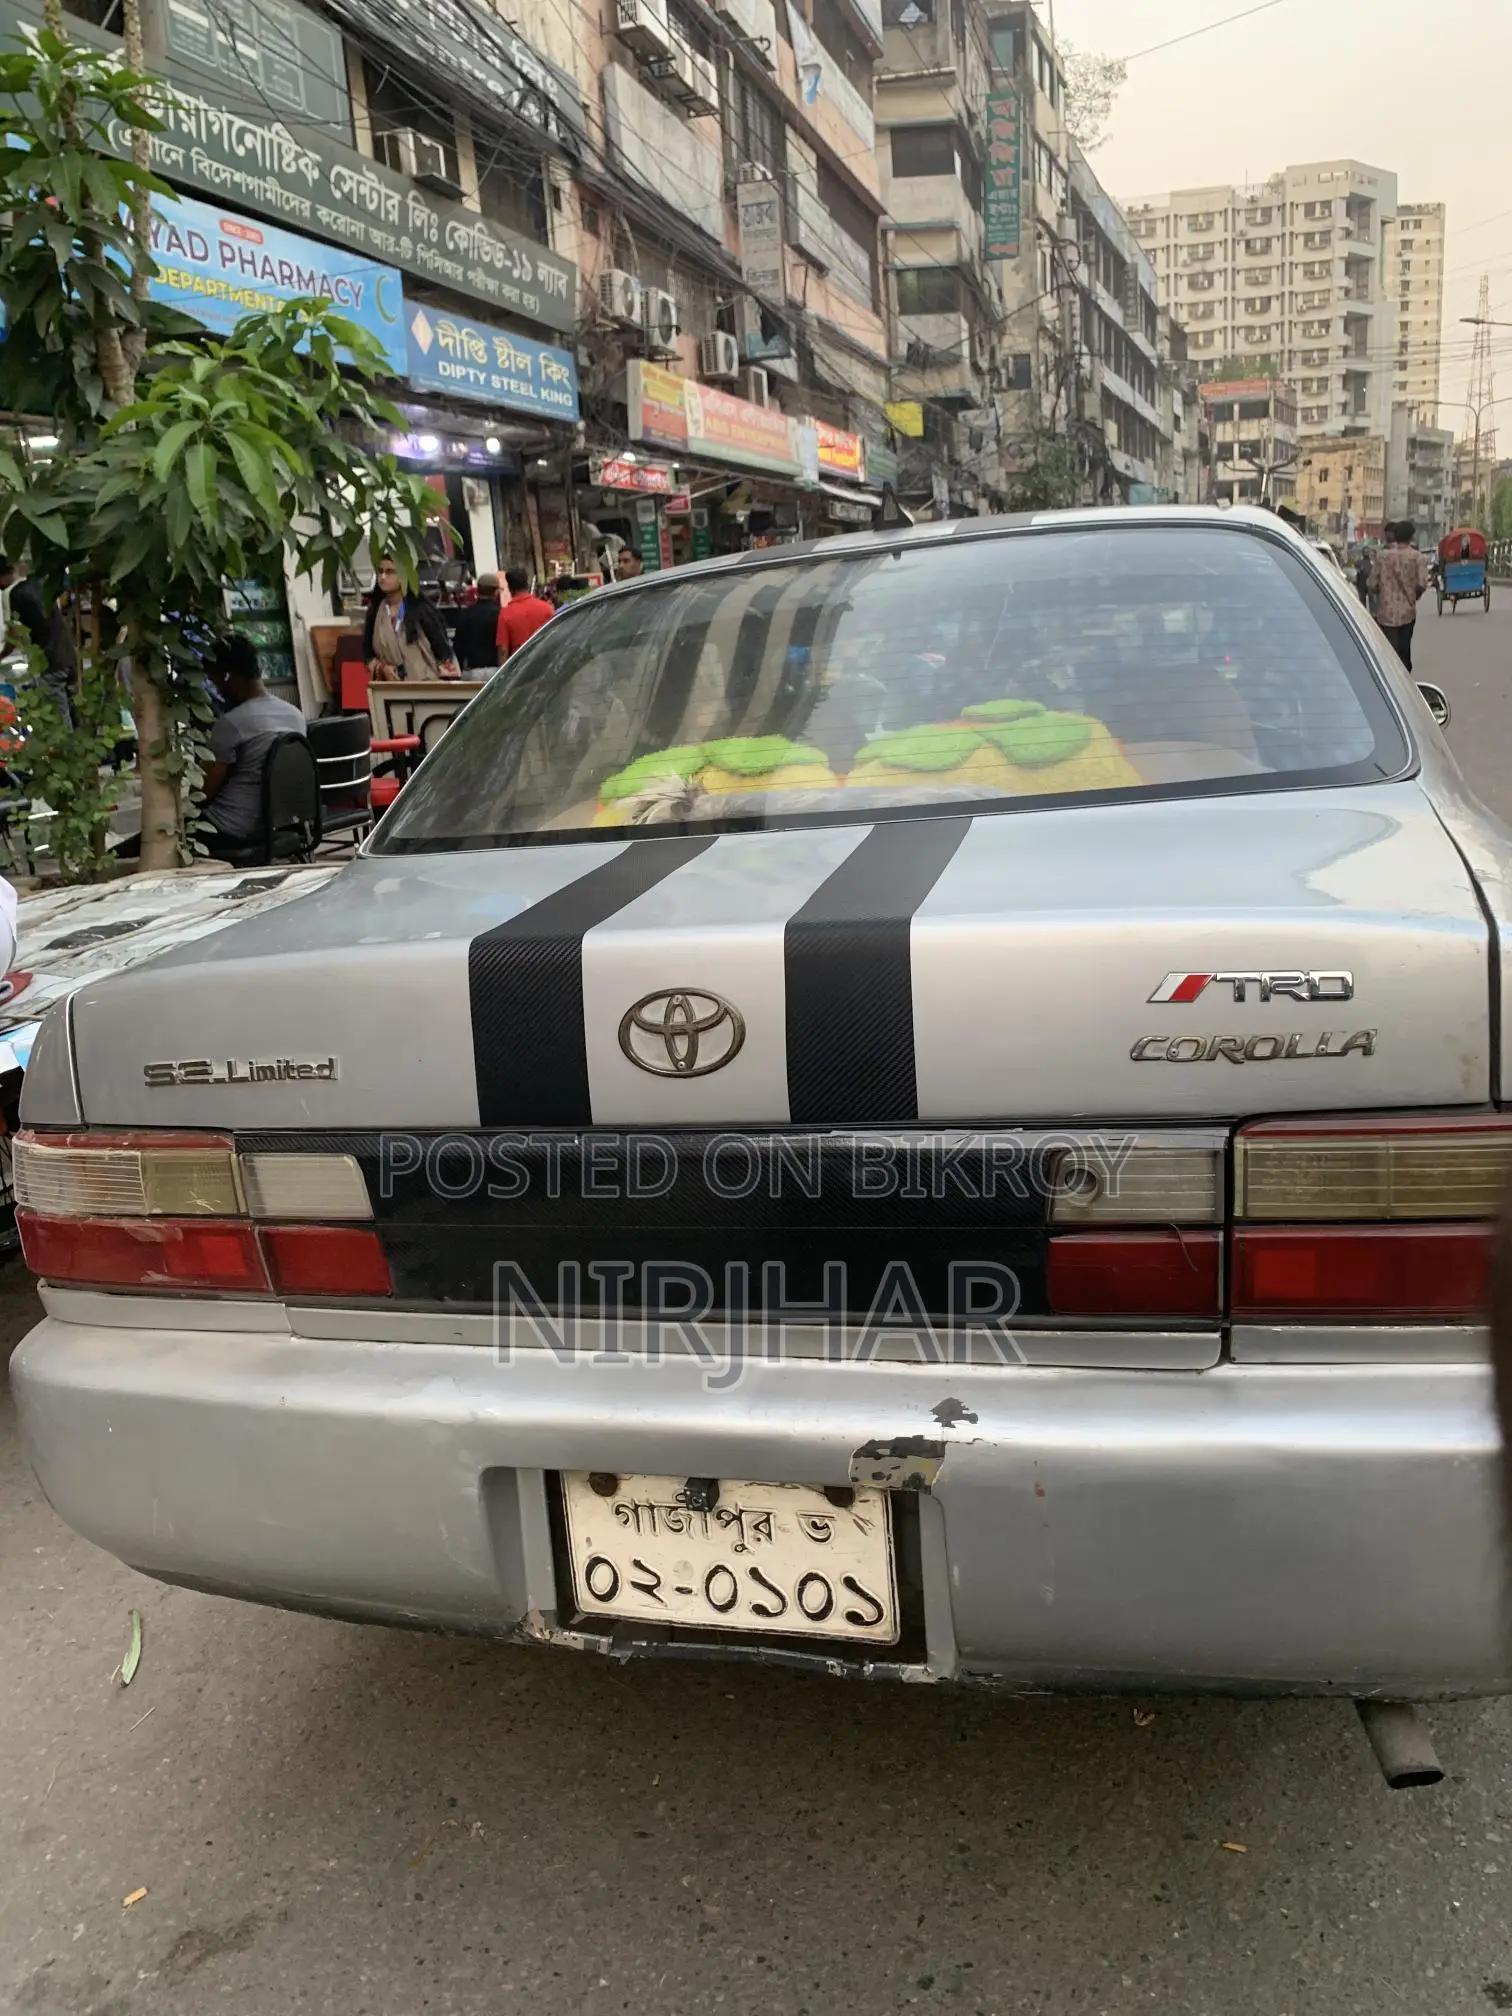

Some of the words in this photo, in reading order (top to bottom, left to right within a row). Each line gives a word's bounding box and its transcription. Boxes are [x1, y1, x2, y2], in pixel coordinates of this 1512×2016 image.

[330, 163, 402, 227] সেন্টার
[315, 203, 365, 243] করোনা
[155, 264, 287, 314] DEPARTMENTA
[218, 240, 364, 308] PHARMACY
[435, 319, 489, 365] দীপ্তি
[438, 360, 487, 386] DIPTY
[491, 374, 538, 400] STEEL
[540, 387, 574, 407] KING
[1216, 970, 1354, 1002] TRD
[1129, 1028, 1378, 1064] COROLLA
[614, 1499, 776, 1555] গাজীপুর
[583, 1554, 886, 1628] ০২-০১০১
